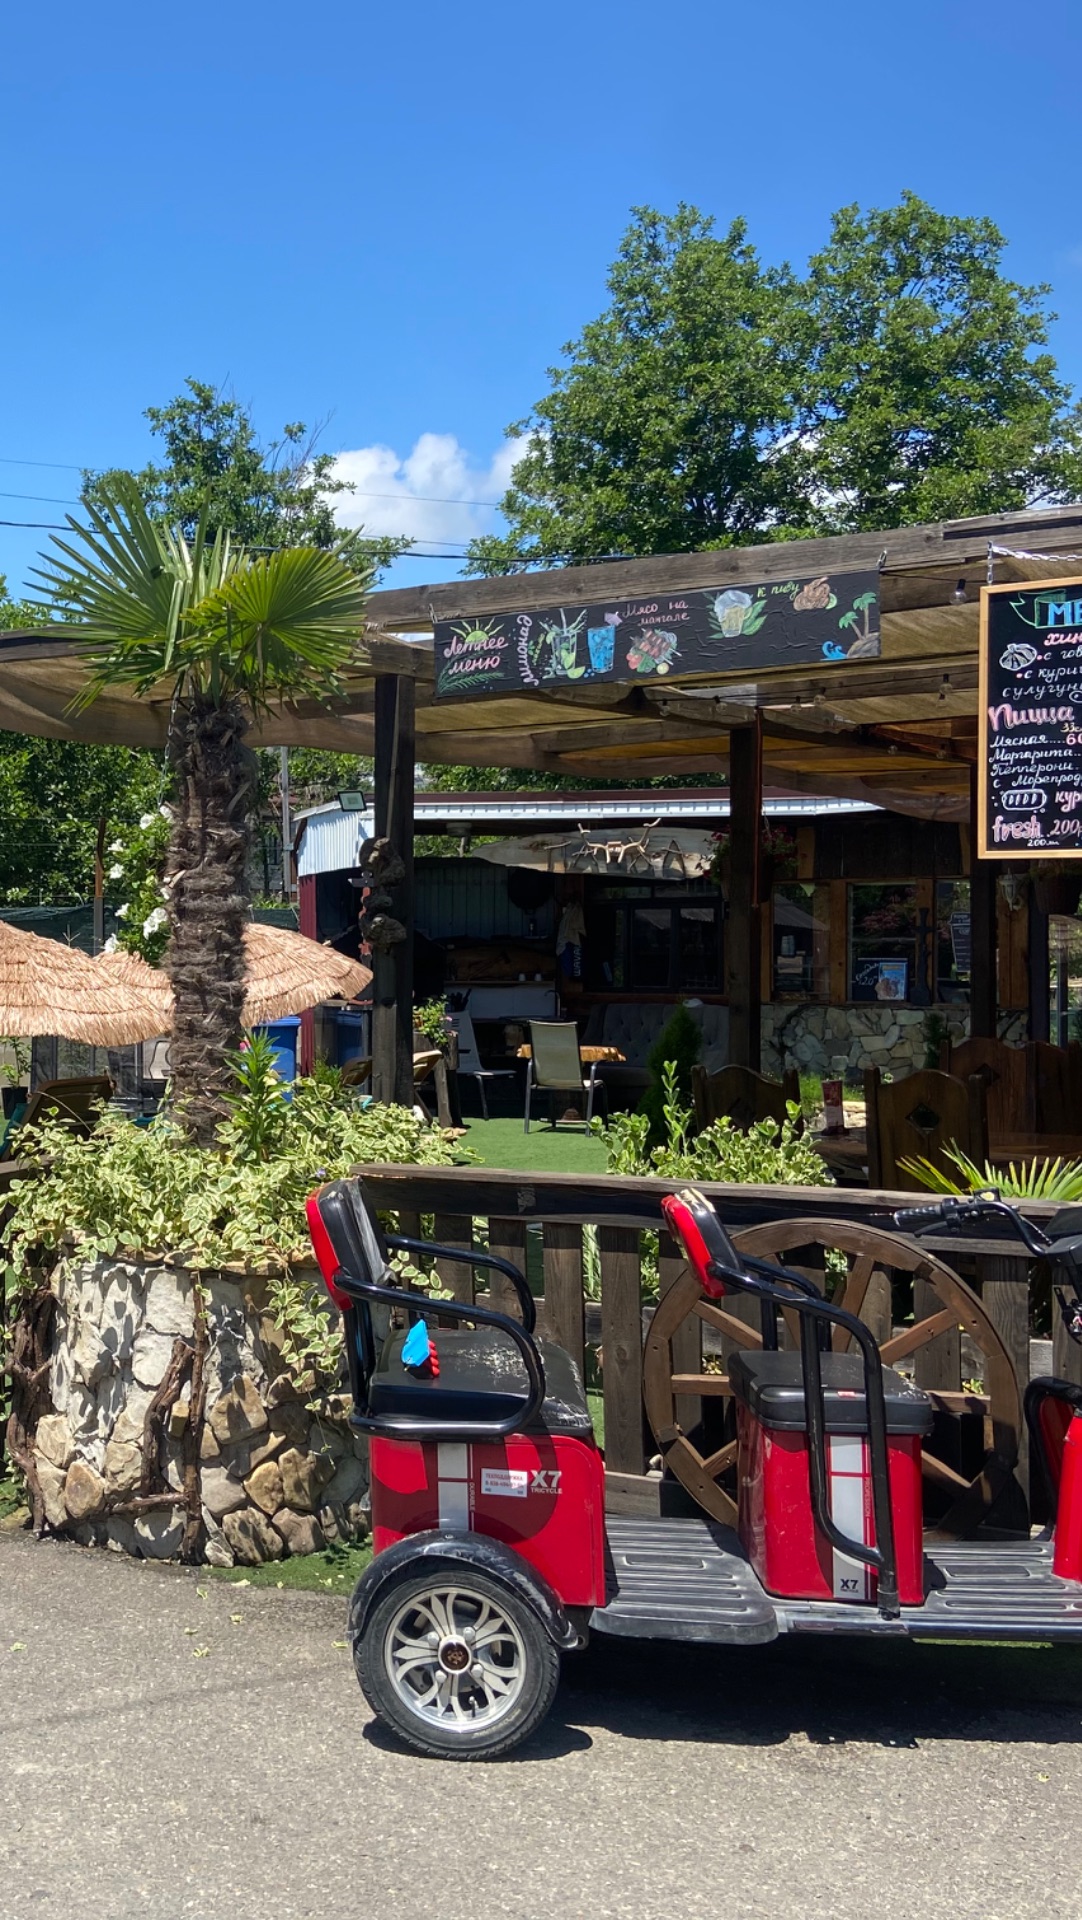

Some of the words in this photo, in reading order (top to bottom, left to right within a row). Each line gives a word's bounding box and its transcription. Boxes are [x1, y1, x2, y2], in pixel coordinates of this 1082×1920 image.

[622, 603, 659, 618] Мясо
[669, 601, 688, 610] на
[639, 612, 690, 627] мангале
[443, 635, 509, 659] Летнее
[448, 655, 500, 674] меню
[1038, 666, 1082, 683] кури
[988, 703, 1075, 732] Пицца
[992, 815, 1041, 842] fresh
[530, 1470, 562, 1488] X7
[531, 1487, 563, 1495] TRICYCLE
[840, 1578, 859, 1590] X7
